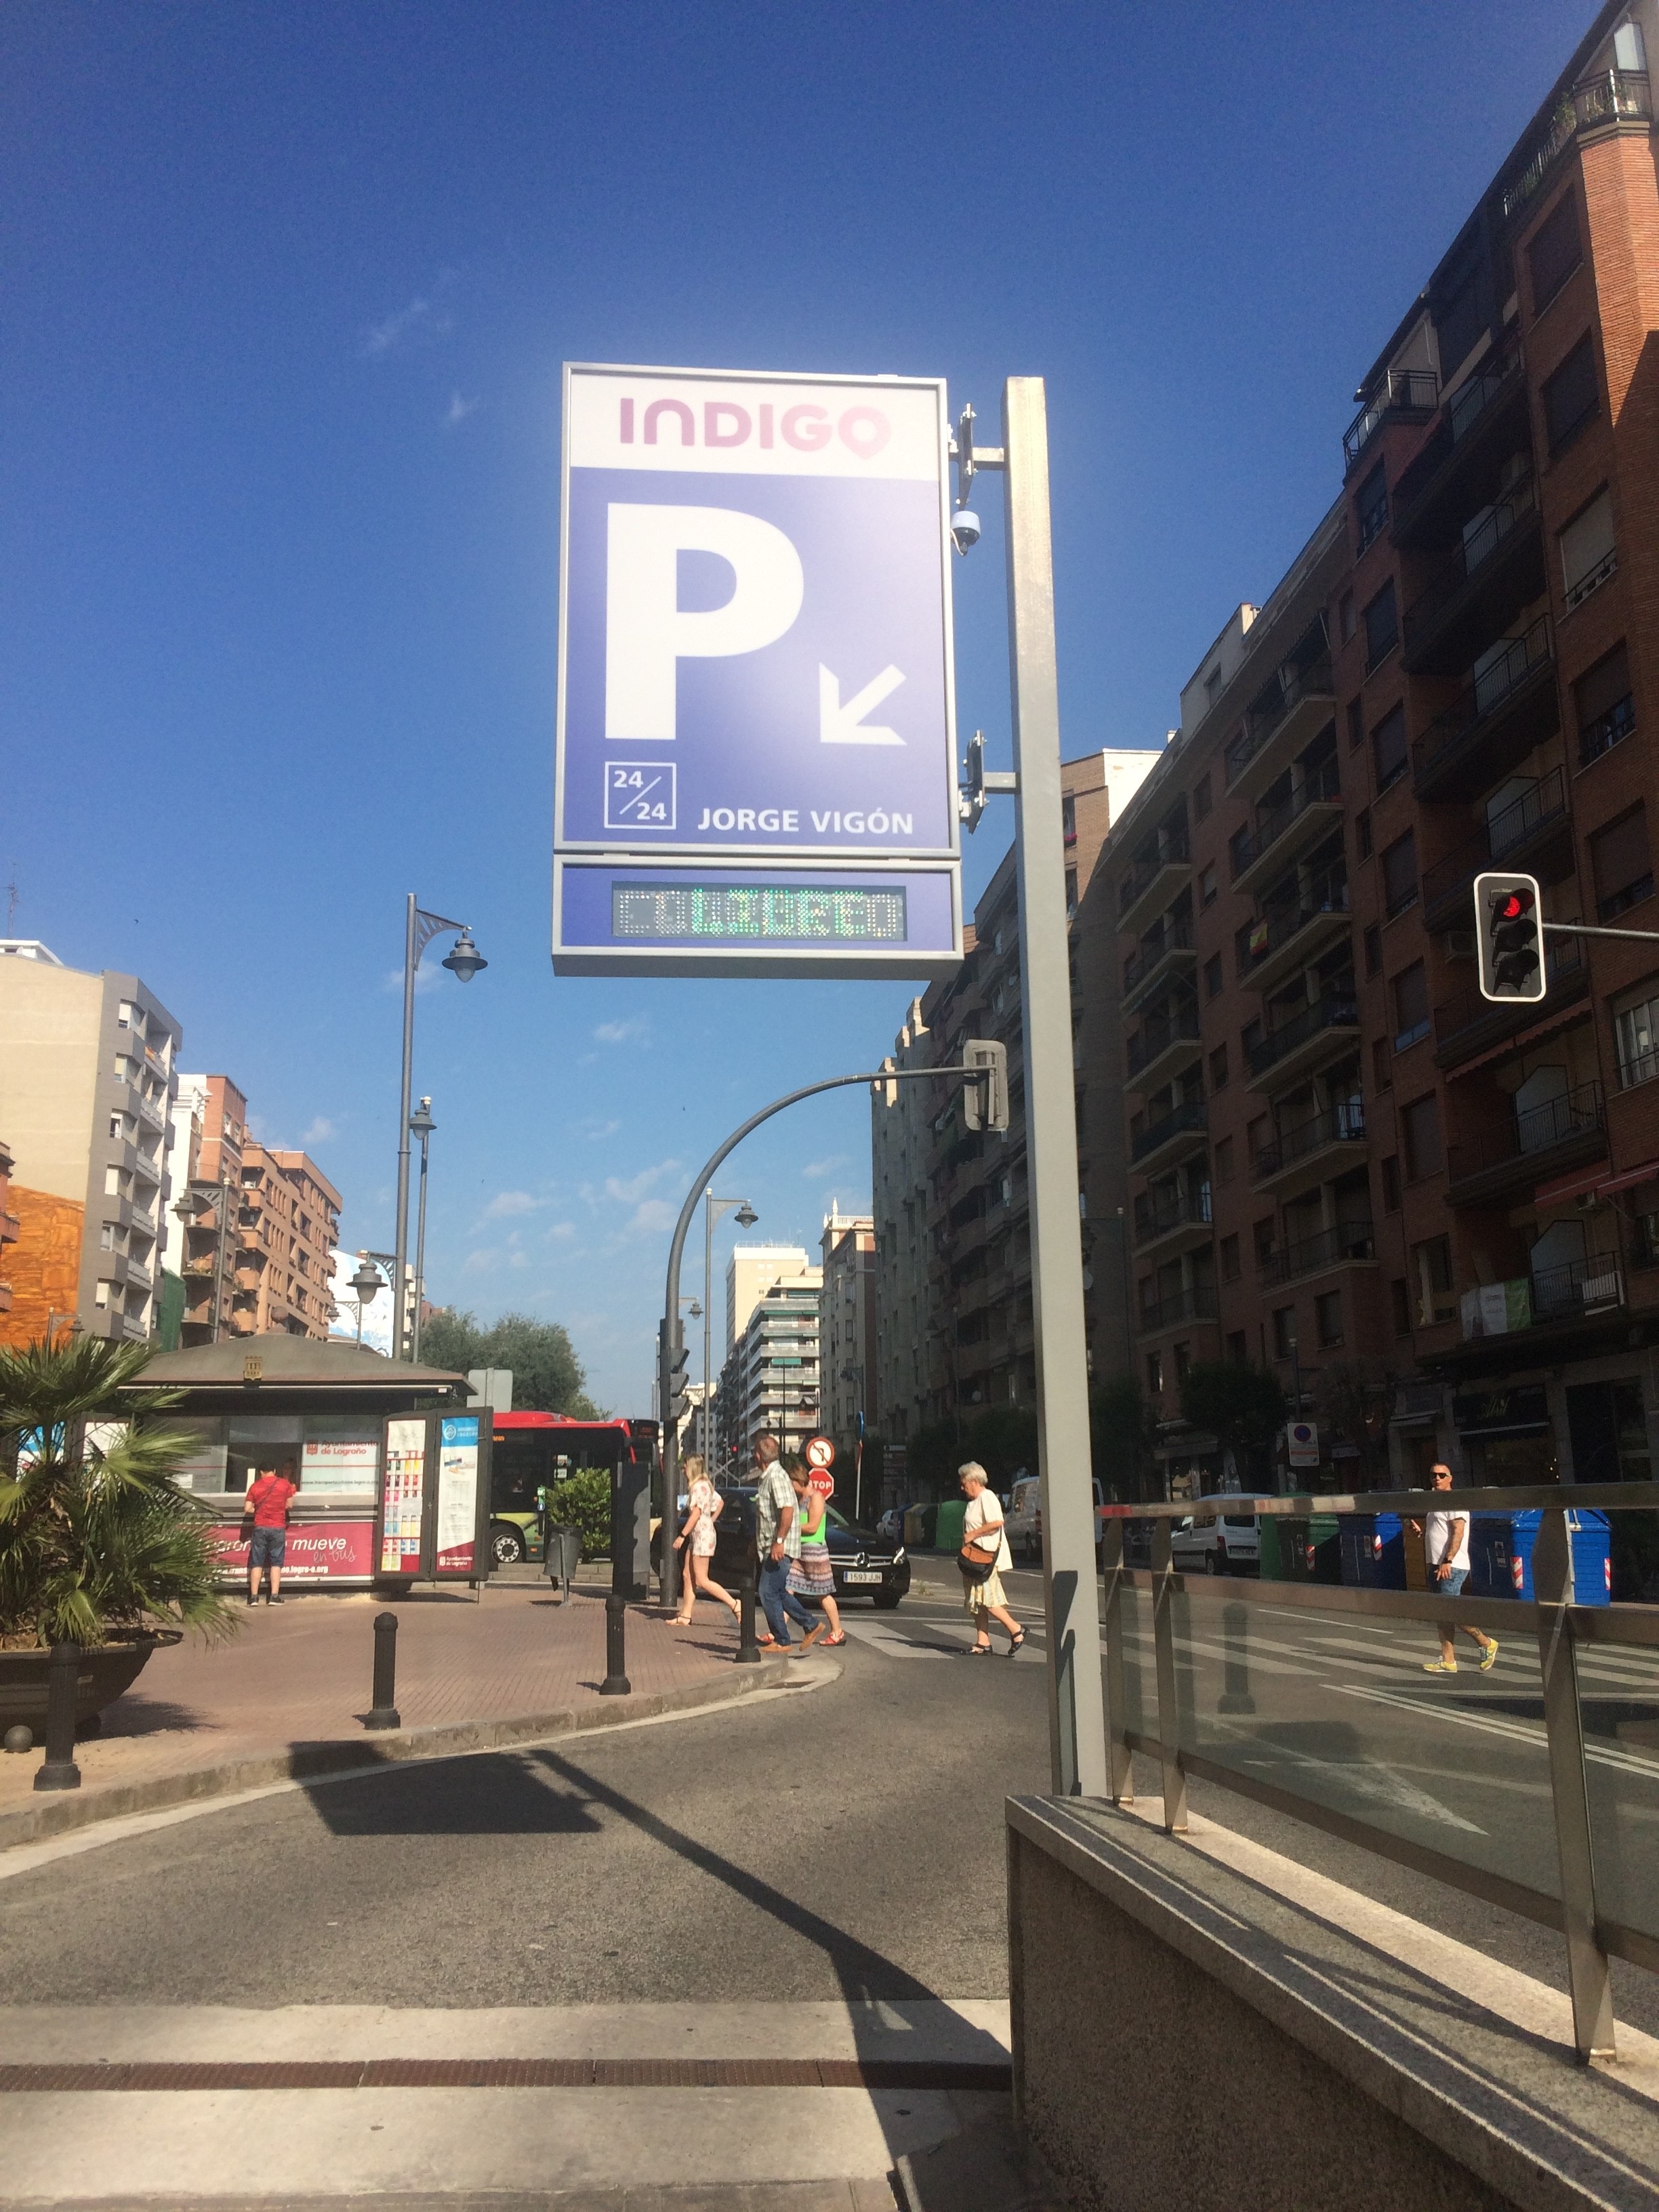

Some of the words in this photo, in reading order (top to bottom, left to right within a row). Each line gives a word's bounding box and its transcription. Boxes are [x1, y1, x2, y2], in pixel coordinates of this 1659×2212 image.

[620, 397, 892, 460] INDIGO
[605, 502, 804, 740] P
[613, 770, 644, 789] 24
[636, 801, 668, 822] 24
[697, 807, 800, 833] JORGE
[811, 806, 914, 836] VIGÓN
[333, 1448, 367, 1456] Logroño
[292, 1537, 347, 1551] mueve
[313, 1551, 327, 1563] en
